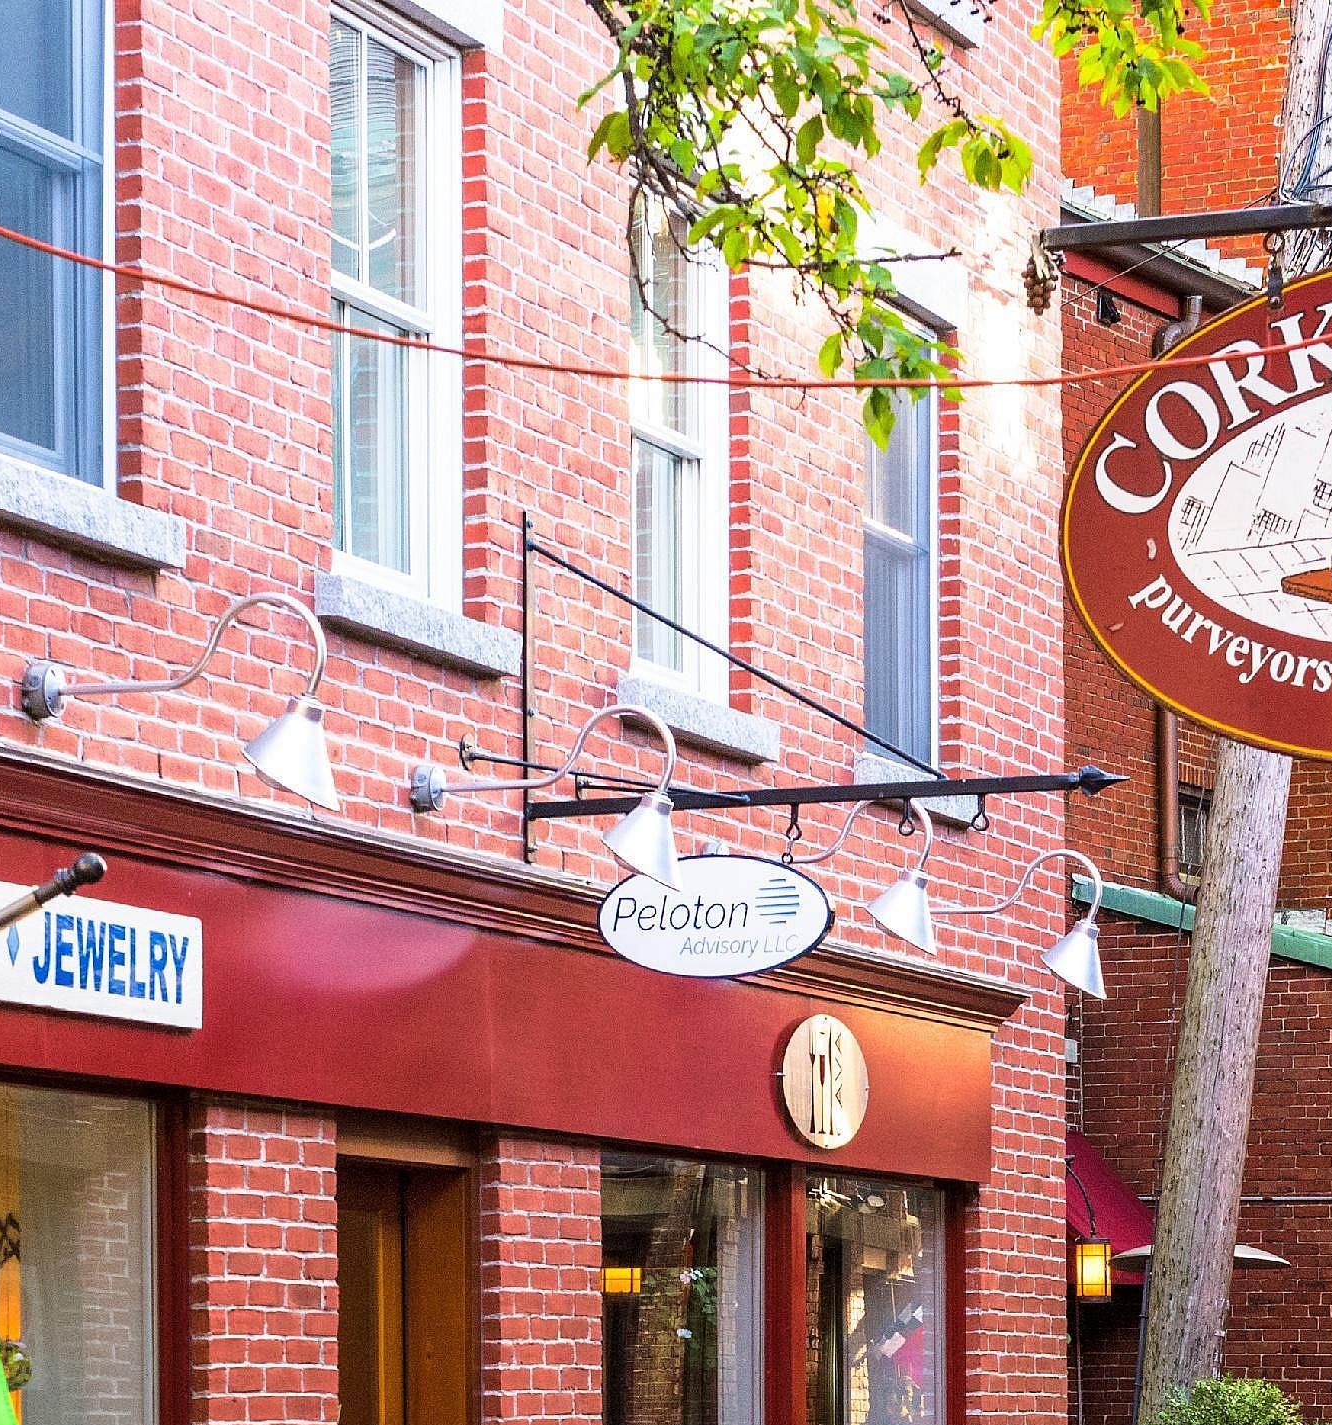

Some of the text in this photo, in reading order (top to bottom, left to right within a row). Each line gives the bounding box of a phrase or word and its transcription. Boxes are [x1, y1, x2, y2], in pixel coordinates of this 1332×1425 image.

[612, 894, 749, 932] Peloton
[33, 911, 190, 1005] JEWELRY
[679, 934, 799, 959] Advisory LLC
